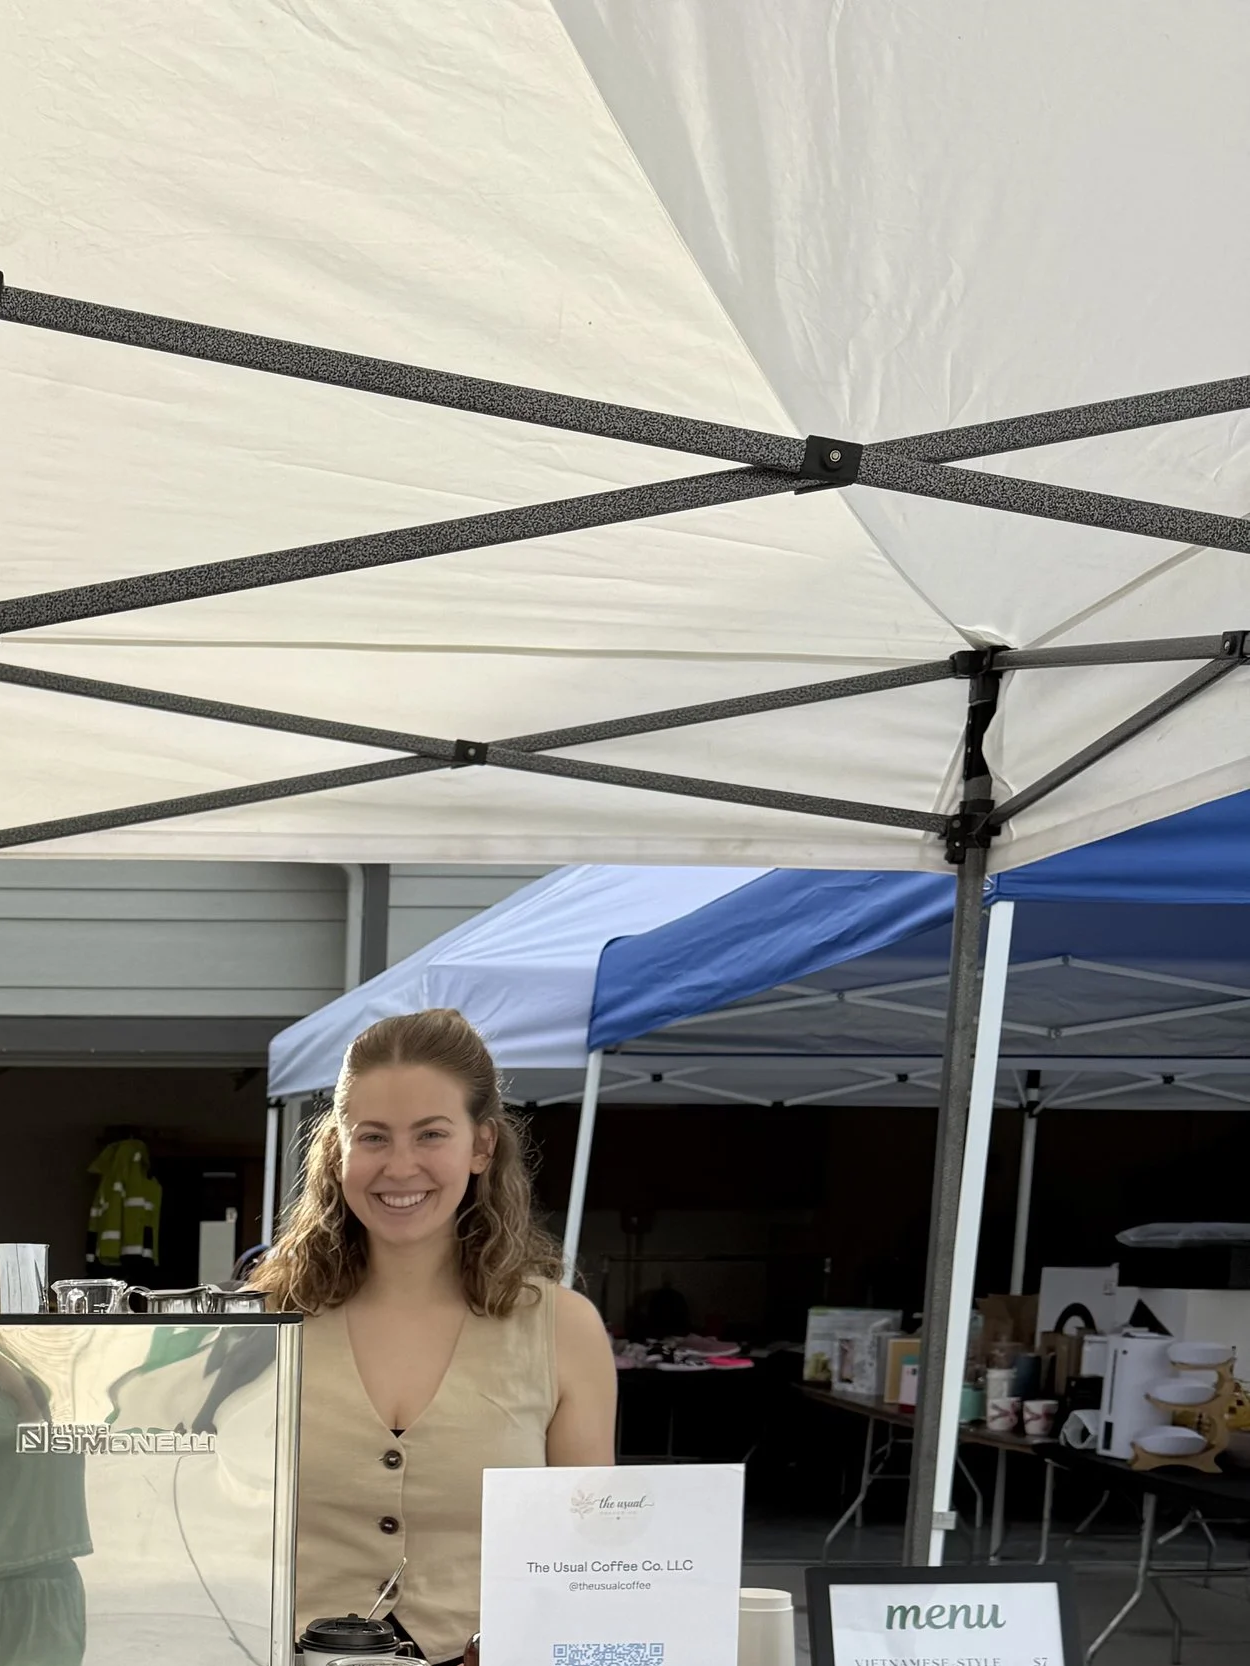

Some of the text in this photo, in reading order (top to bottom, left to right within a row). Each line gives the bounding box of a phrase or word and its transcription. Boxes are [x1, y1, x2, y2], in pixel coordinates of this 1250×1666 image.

[50, 1433, 217, 1454] SIMONELLI
[616, 1495, 654, 1509] usual
[526, 1559, 694, 1573] The Usual Coffee Co. LLC
[569, 1581, 651, 1591] @theusualcoffee
[885, 1604, 1007, 1630] menu
